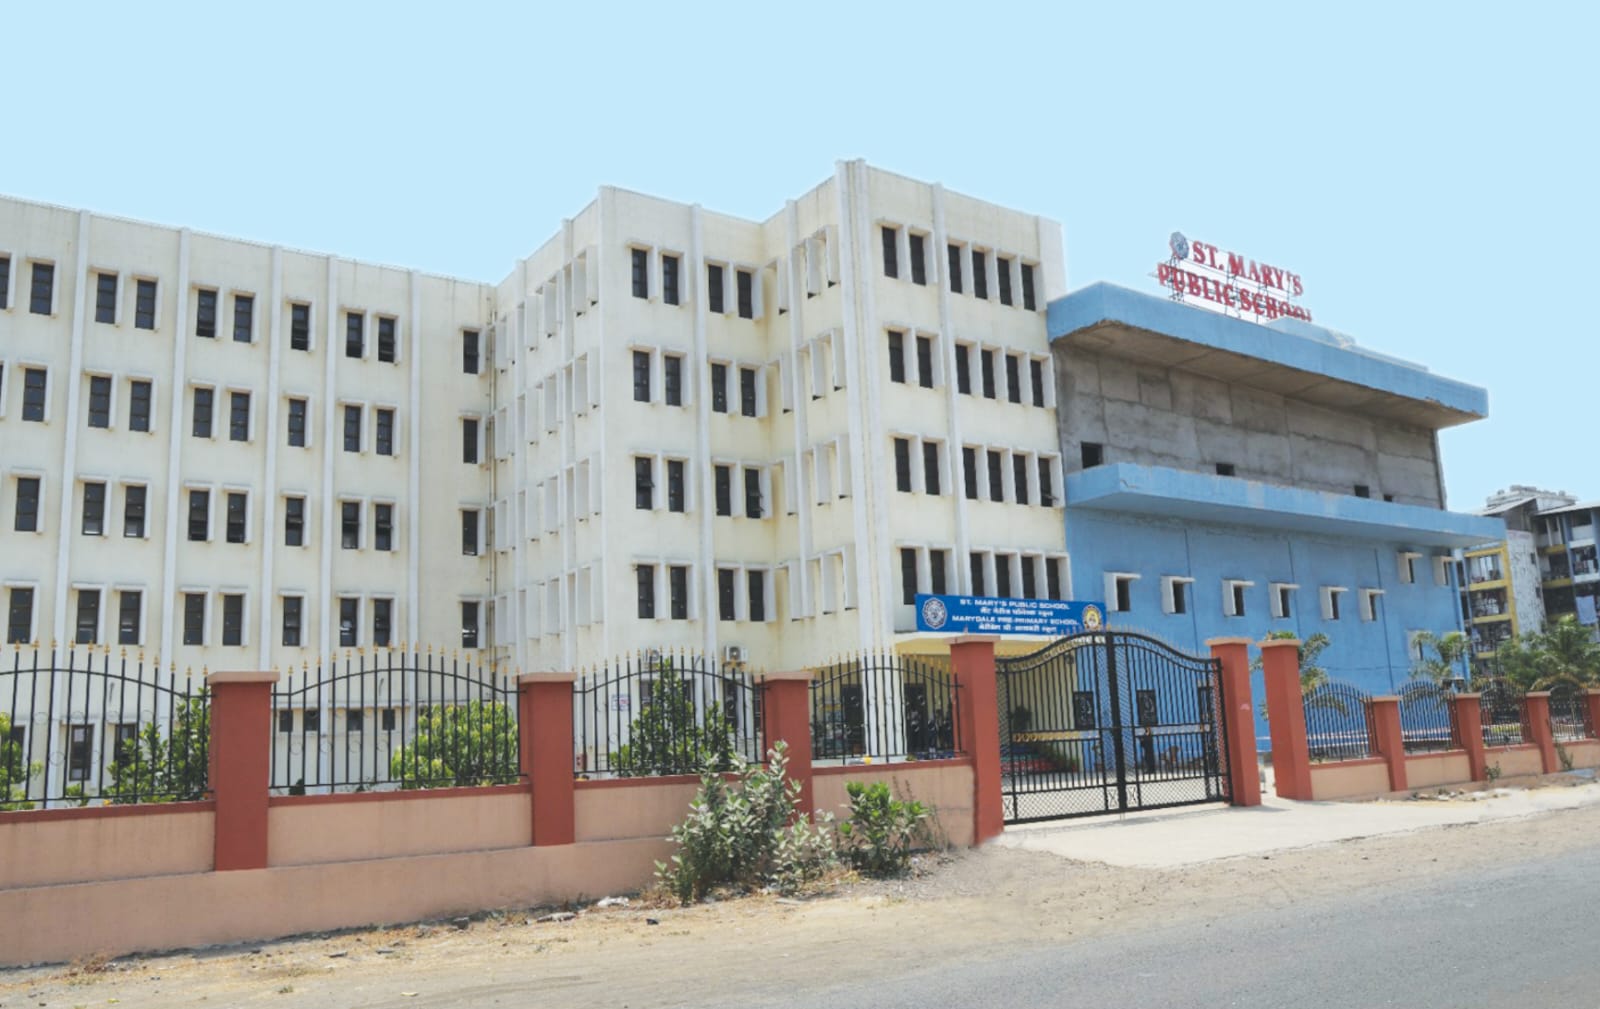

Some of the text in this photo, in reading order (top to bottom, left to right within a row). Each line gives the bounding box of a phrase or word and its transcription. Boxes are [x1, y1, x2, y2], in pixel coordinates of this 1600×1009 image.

[1157, 263, 1236, 307] PUBLIC
[1192, 240, 1304, 296] ST. MARY'S
[960, 599, 973, 607] ST.
